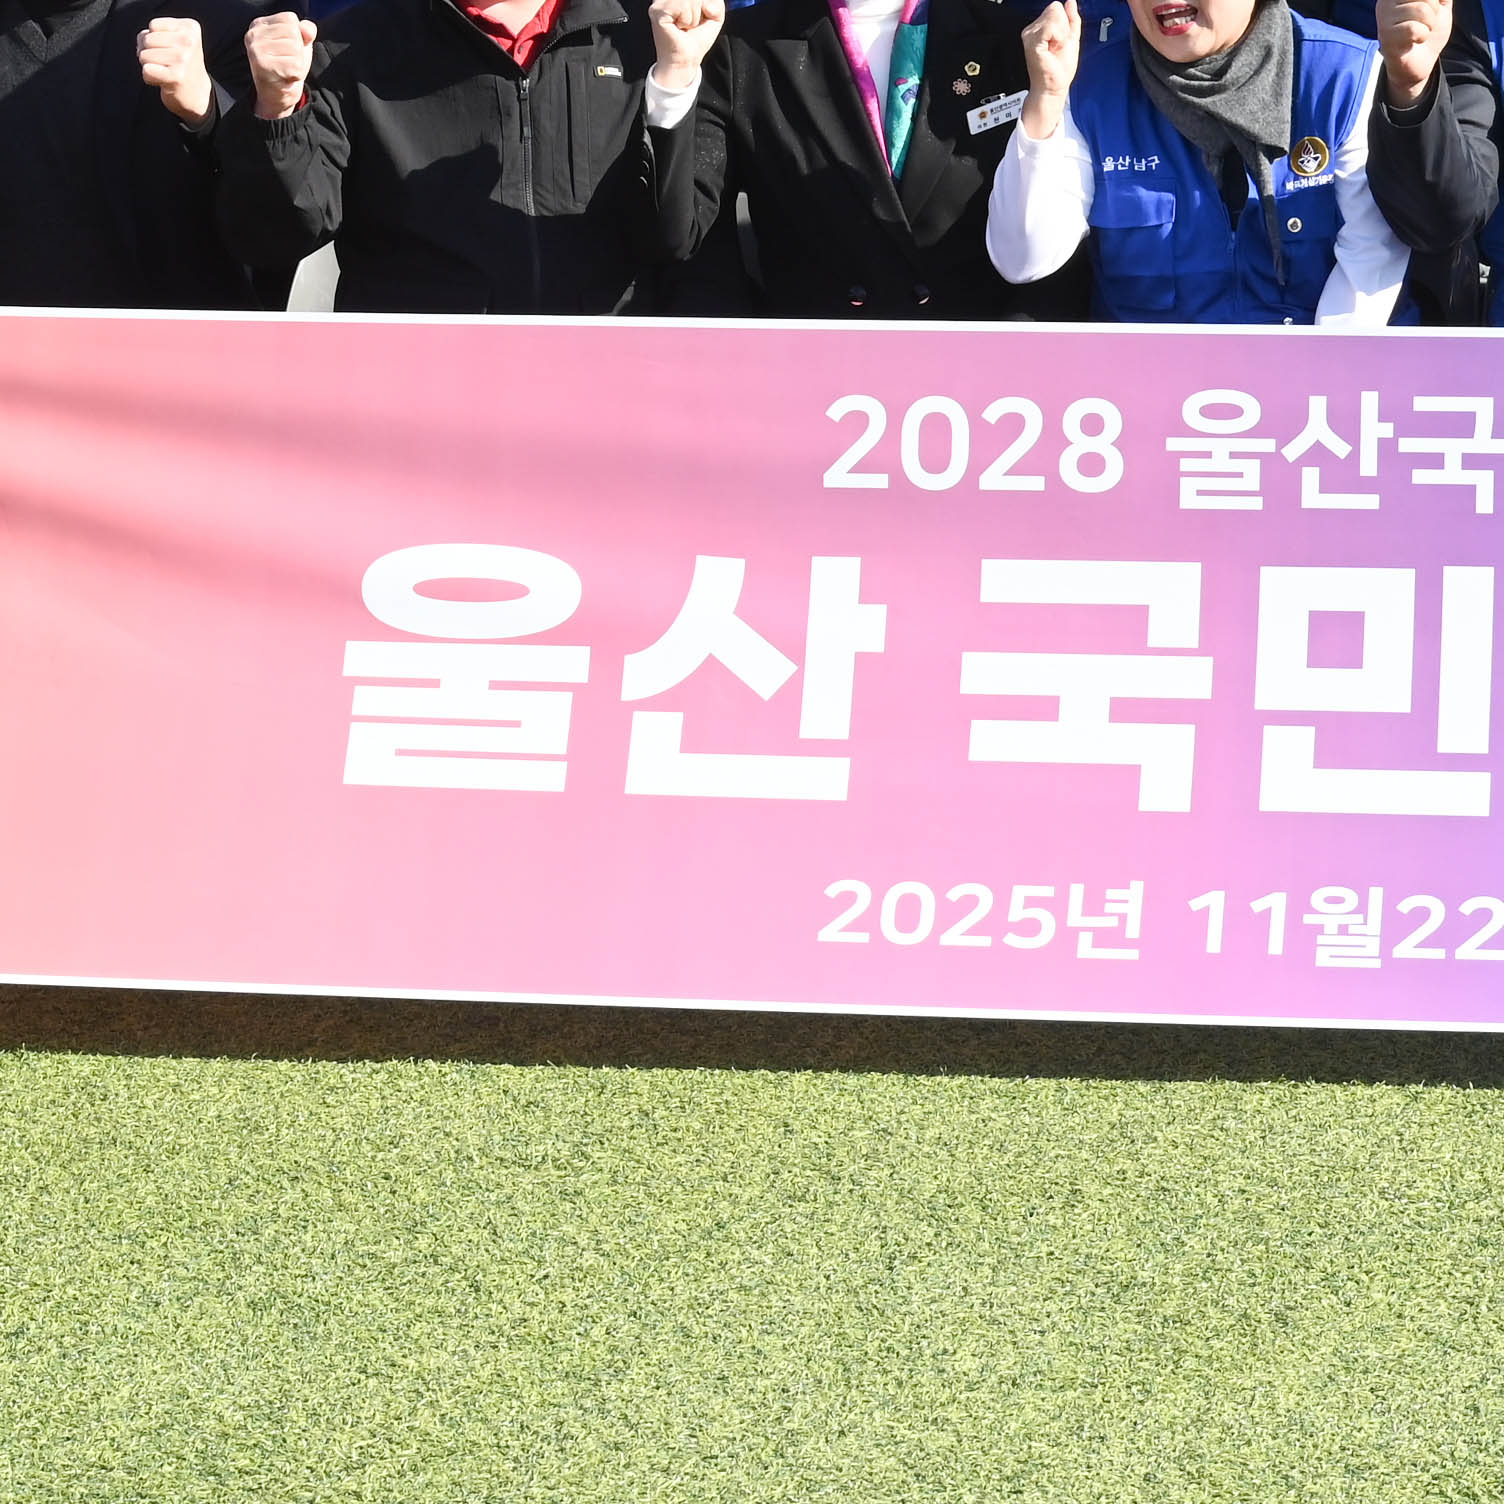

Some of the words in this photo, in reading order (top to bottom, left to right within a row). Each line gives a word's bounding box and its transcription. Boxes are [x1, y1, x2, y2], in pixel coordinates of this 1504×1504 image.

[1101, 155, 1132, 172] 울산
[1133, 155, 1161, 172] 남구
[822, 393, 1125, 494] 2028
[340, 542, 889, 802] 울산
[816, 878, 1146, 970] 2025년
